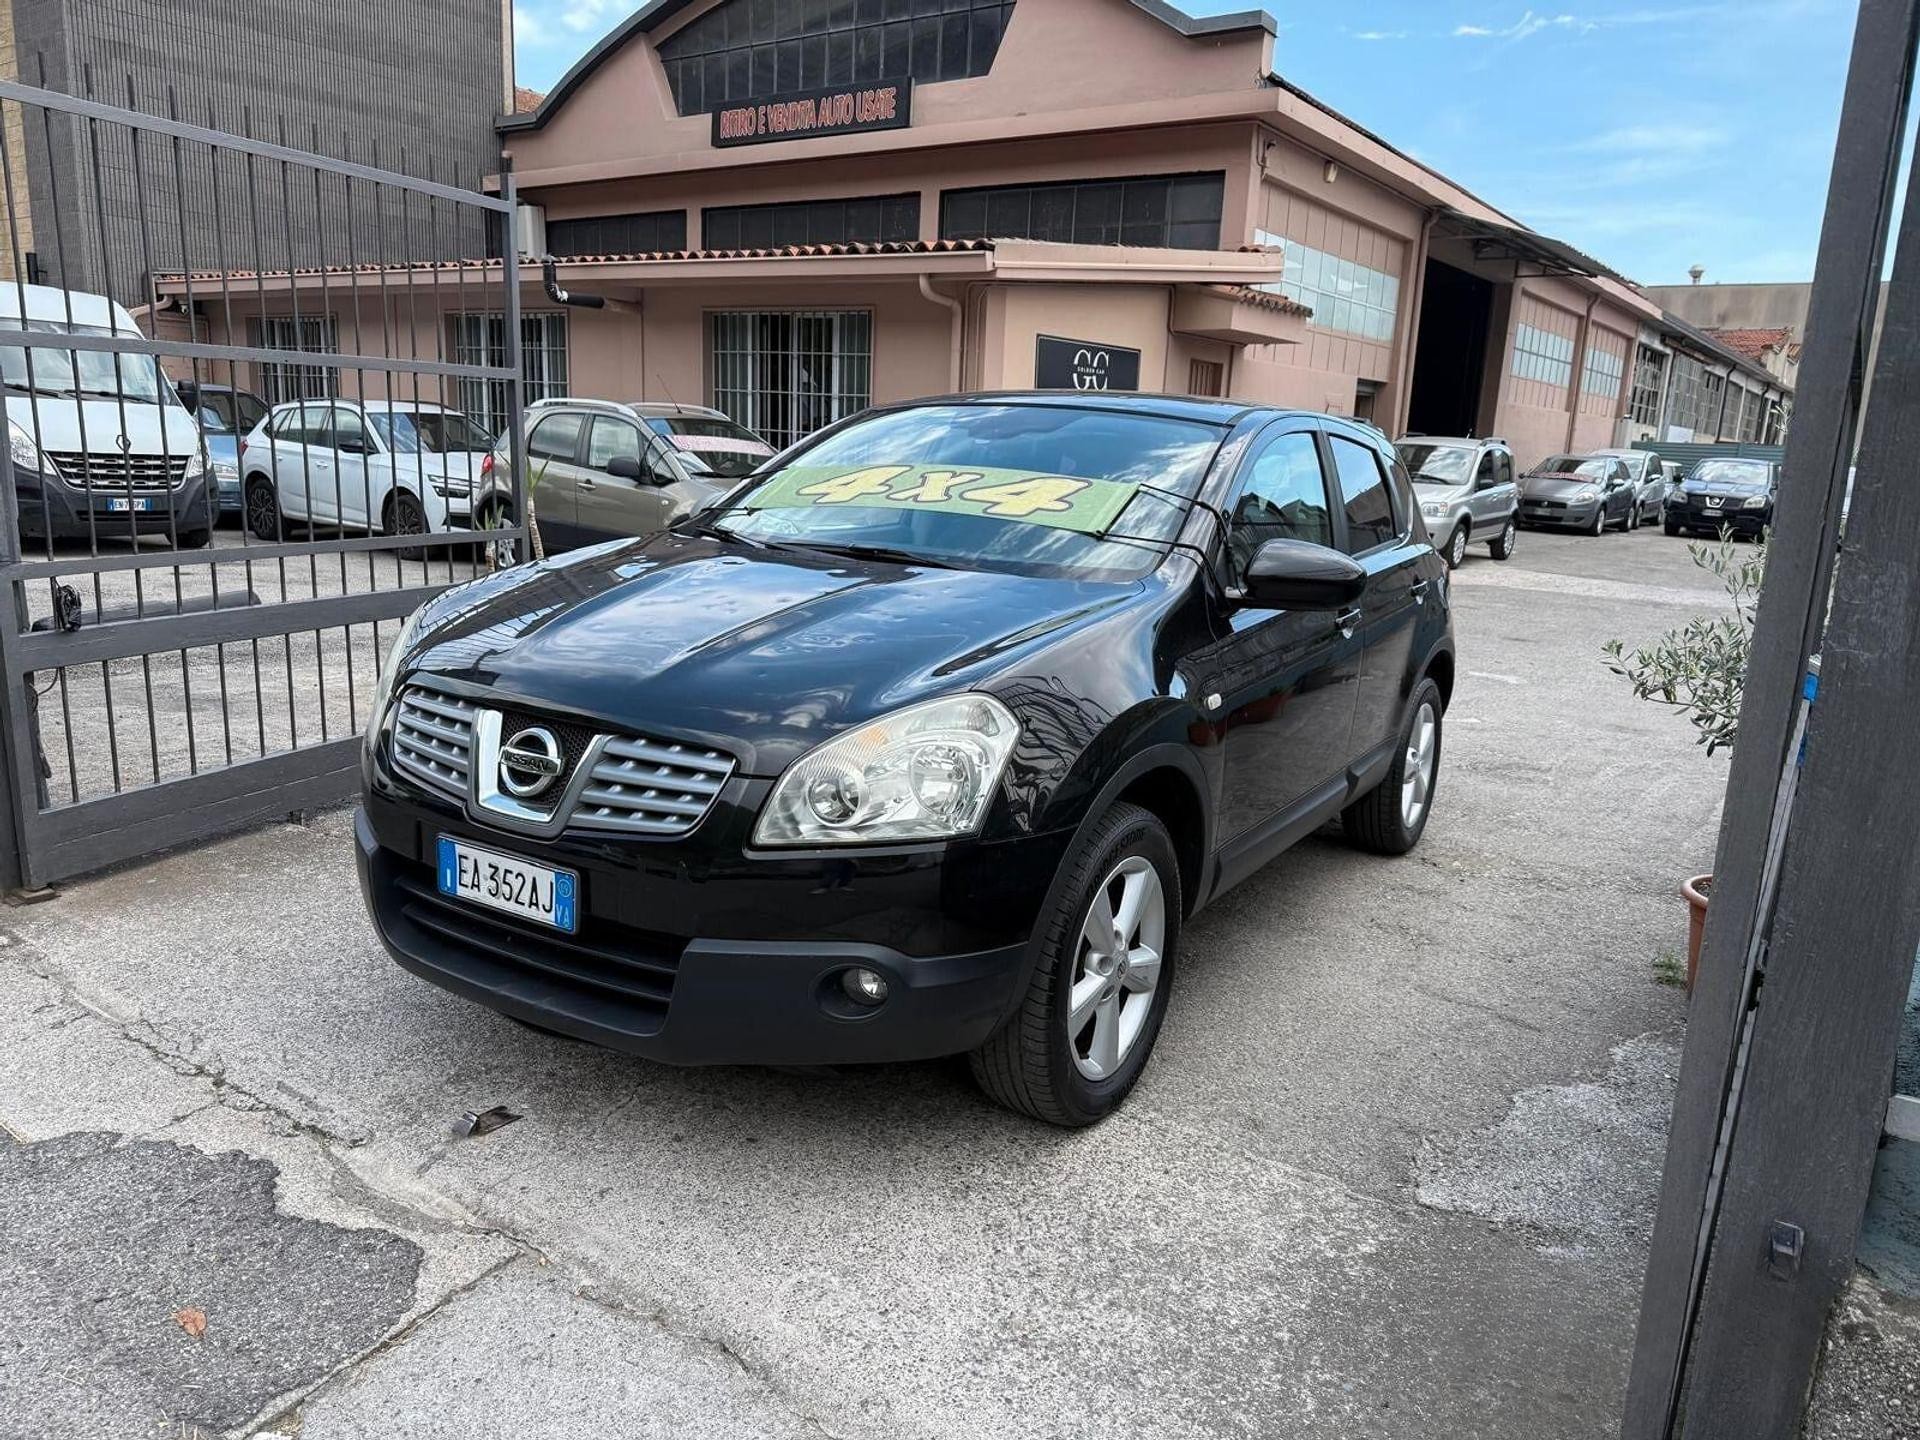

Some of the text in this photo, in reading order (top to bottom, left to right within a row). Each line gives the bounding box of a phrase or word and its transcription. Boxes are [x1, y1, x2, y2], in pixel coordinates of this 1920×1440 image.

[720, 87, 896, 139] RITIRO E VENDITA AUTO USATE
[502, 750, 549, 773] NISSAN
[458, 854, 480, 892] EA
[488, 862, 554, 914] 352AJ
[555, 903, 570, 926] VA
